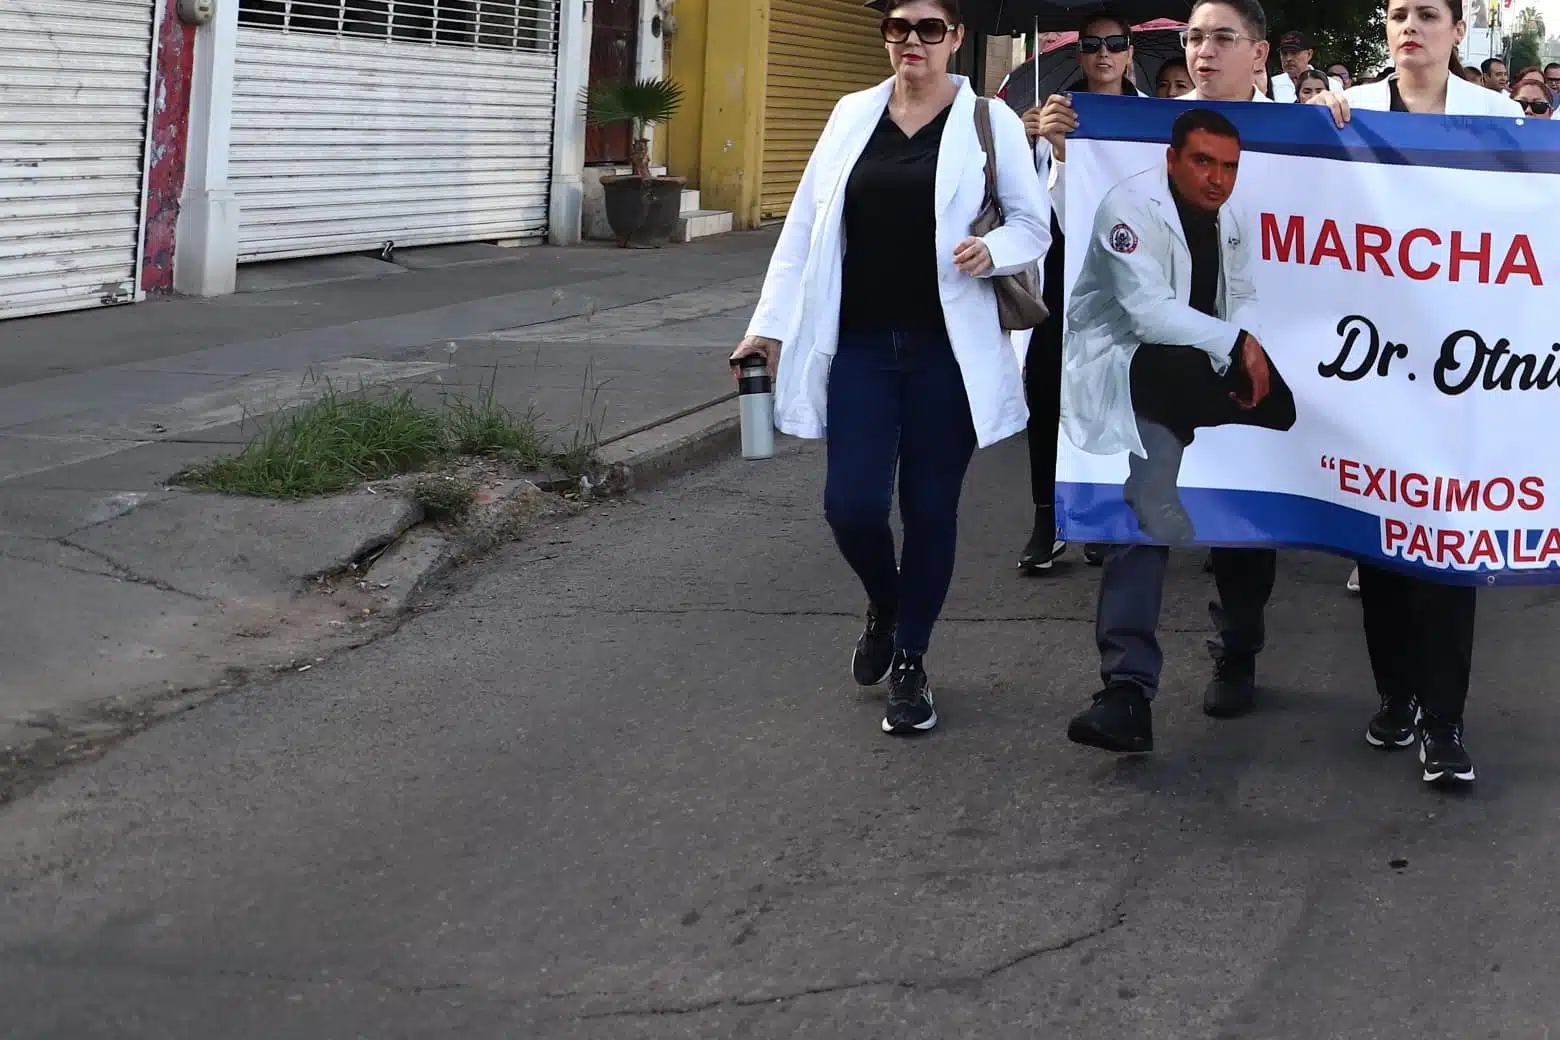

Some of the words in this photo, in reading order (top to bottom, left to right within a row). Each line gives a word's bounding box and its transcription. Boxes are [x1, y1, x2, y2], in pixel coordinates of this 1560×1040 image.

[1259, 212, 1543, 287] MARCHA
[1318, 314, 1418, 382] Dr.
[1320, 453, 1544, 512] “EXIGIMOS
[1383, 518, 1507, 564] PARA
